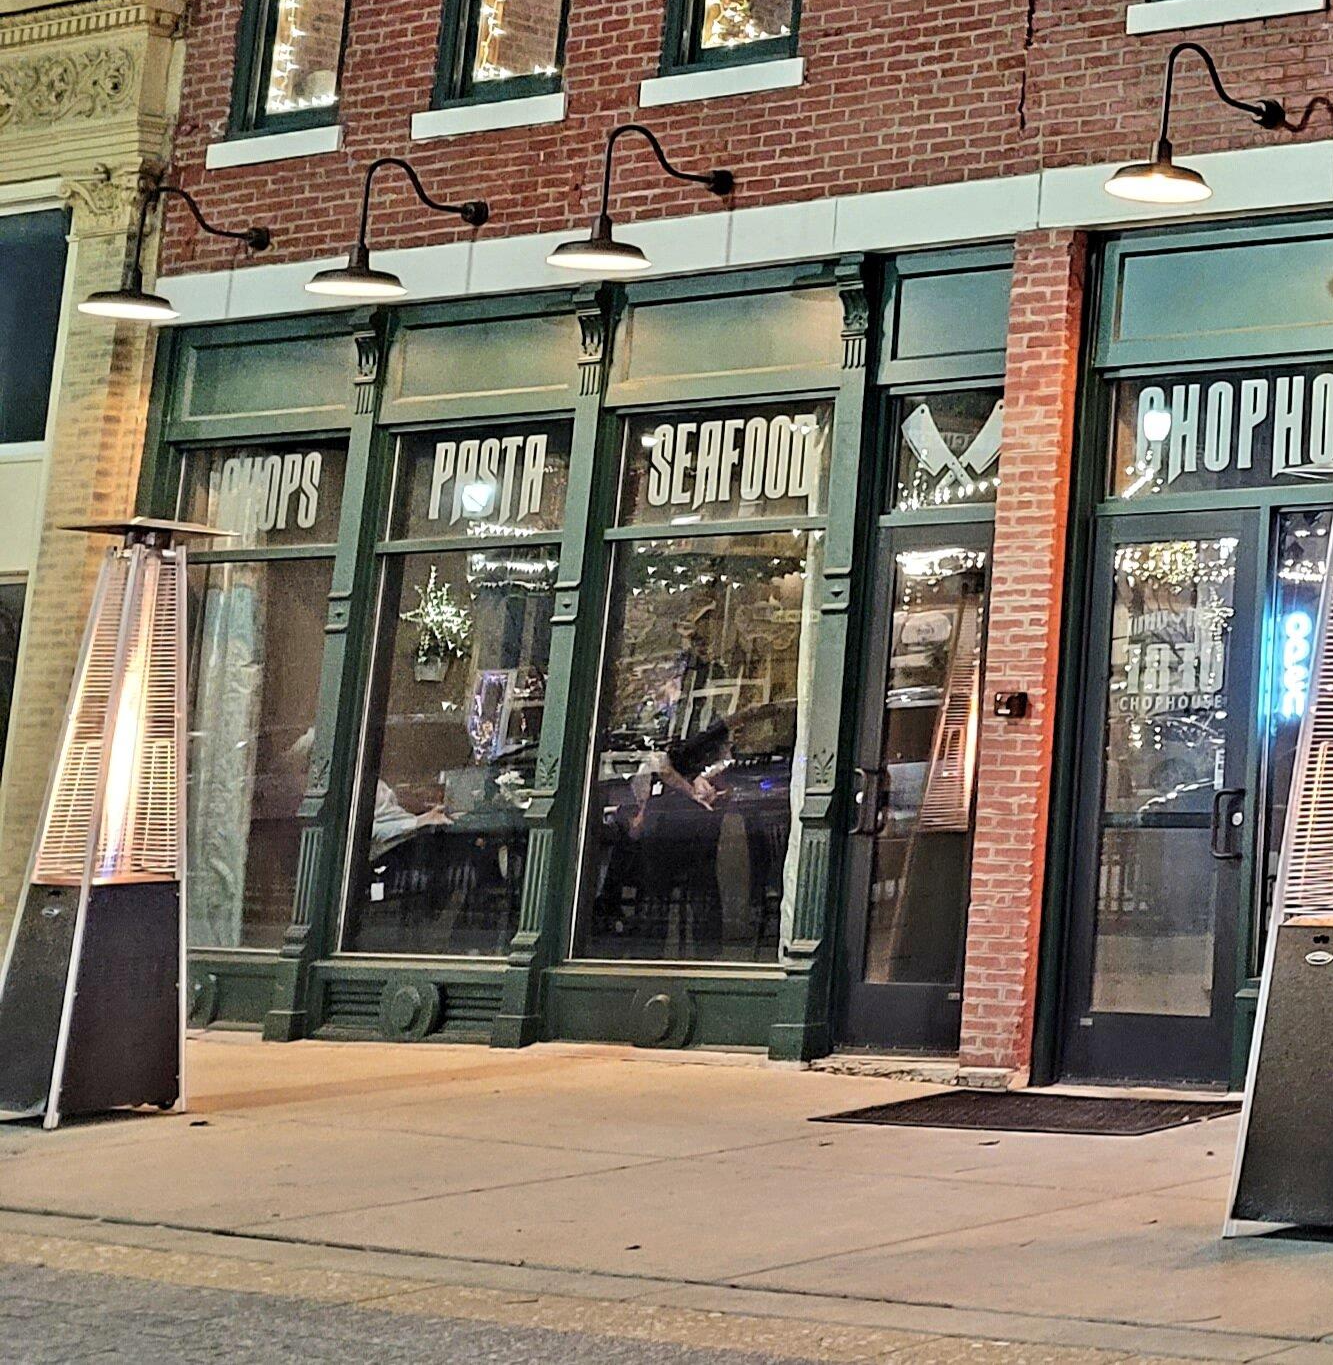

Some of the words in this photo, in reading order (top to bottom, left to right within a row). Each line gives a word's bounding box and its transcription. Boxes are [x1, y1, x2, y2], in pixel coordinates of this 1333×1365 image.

[217, 451, 323, 534] CHOPS
[428, 434, 549, 527] PASTA
[647, 414, 819, 511] SEAFOOD
[1120, 694, 1223, 712] CHOPHOUSE
